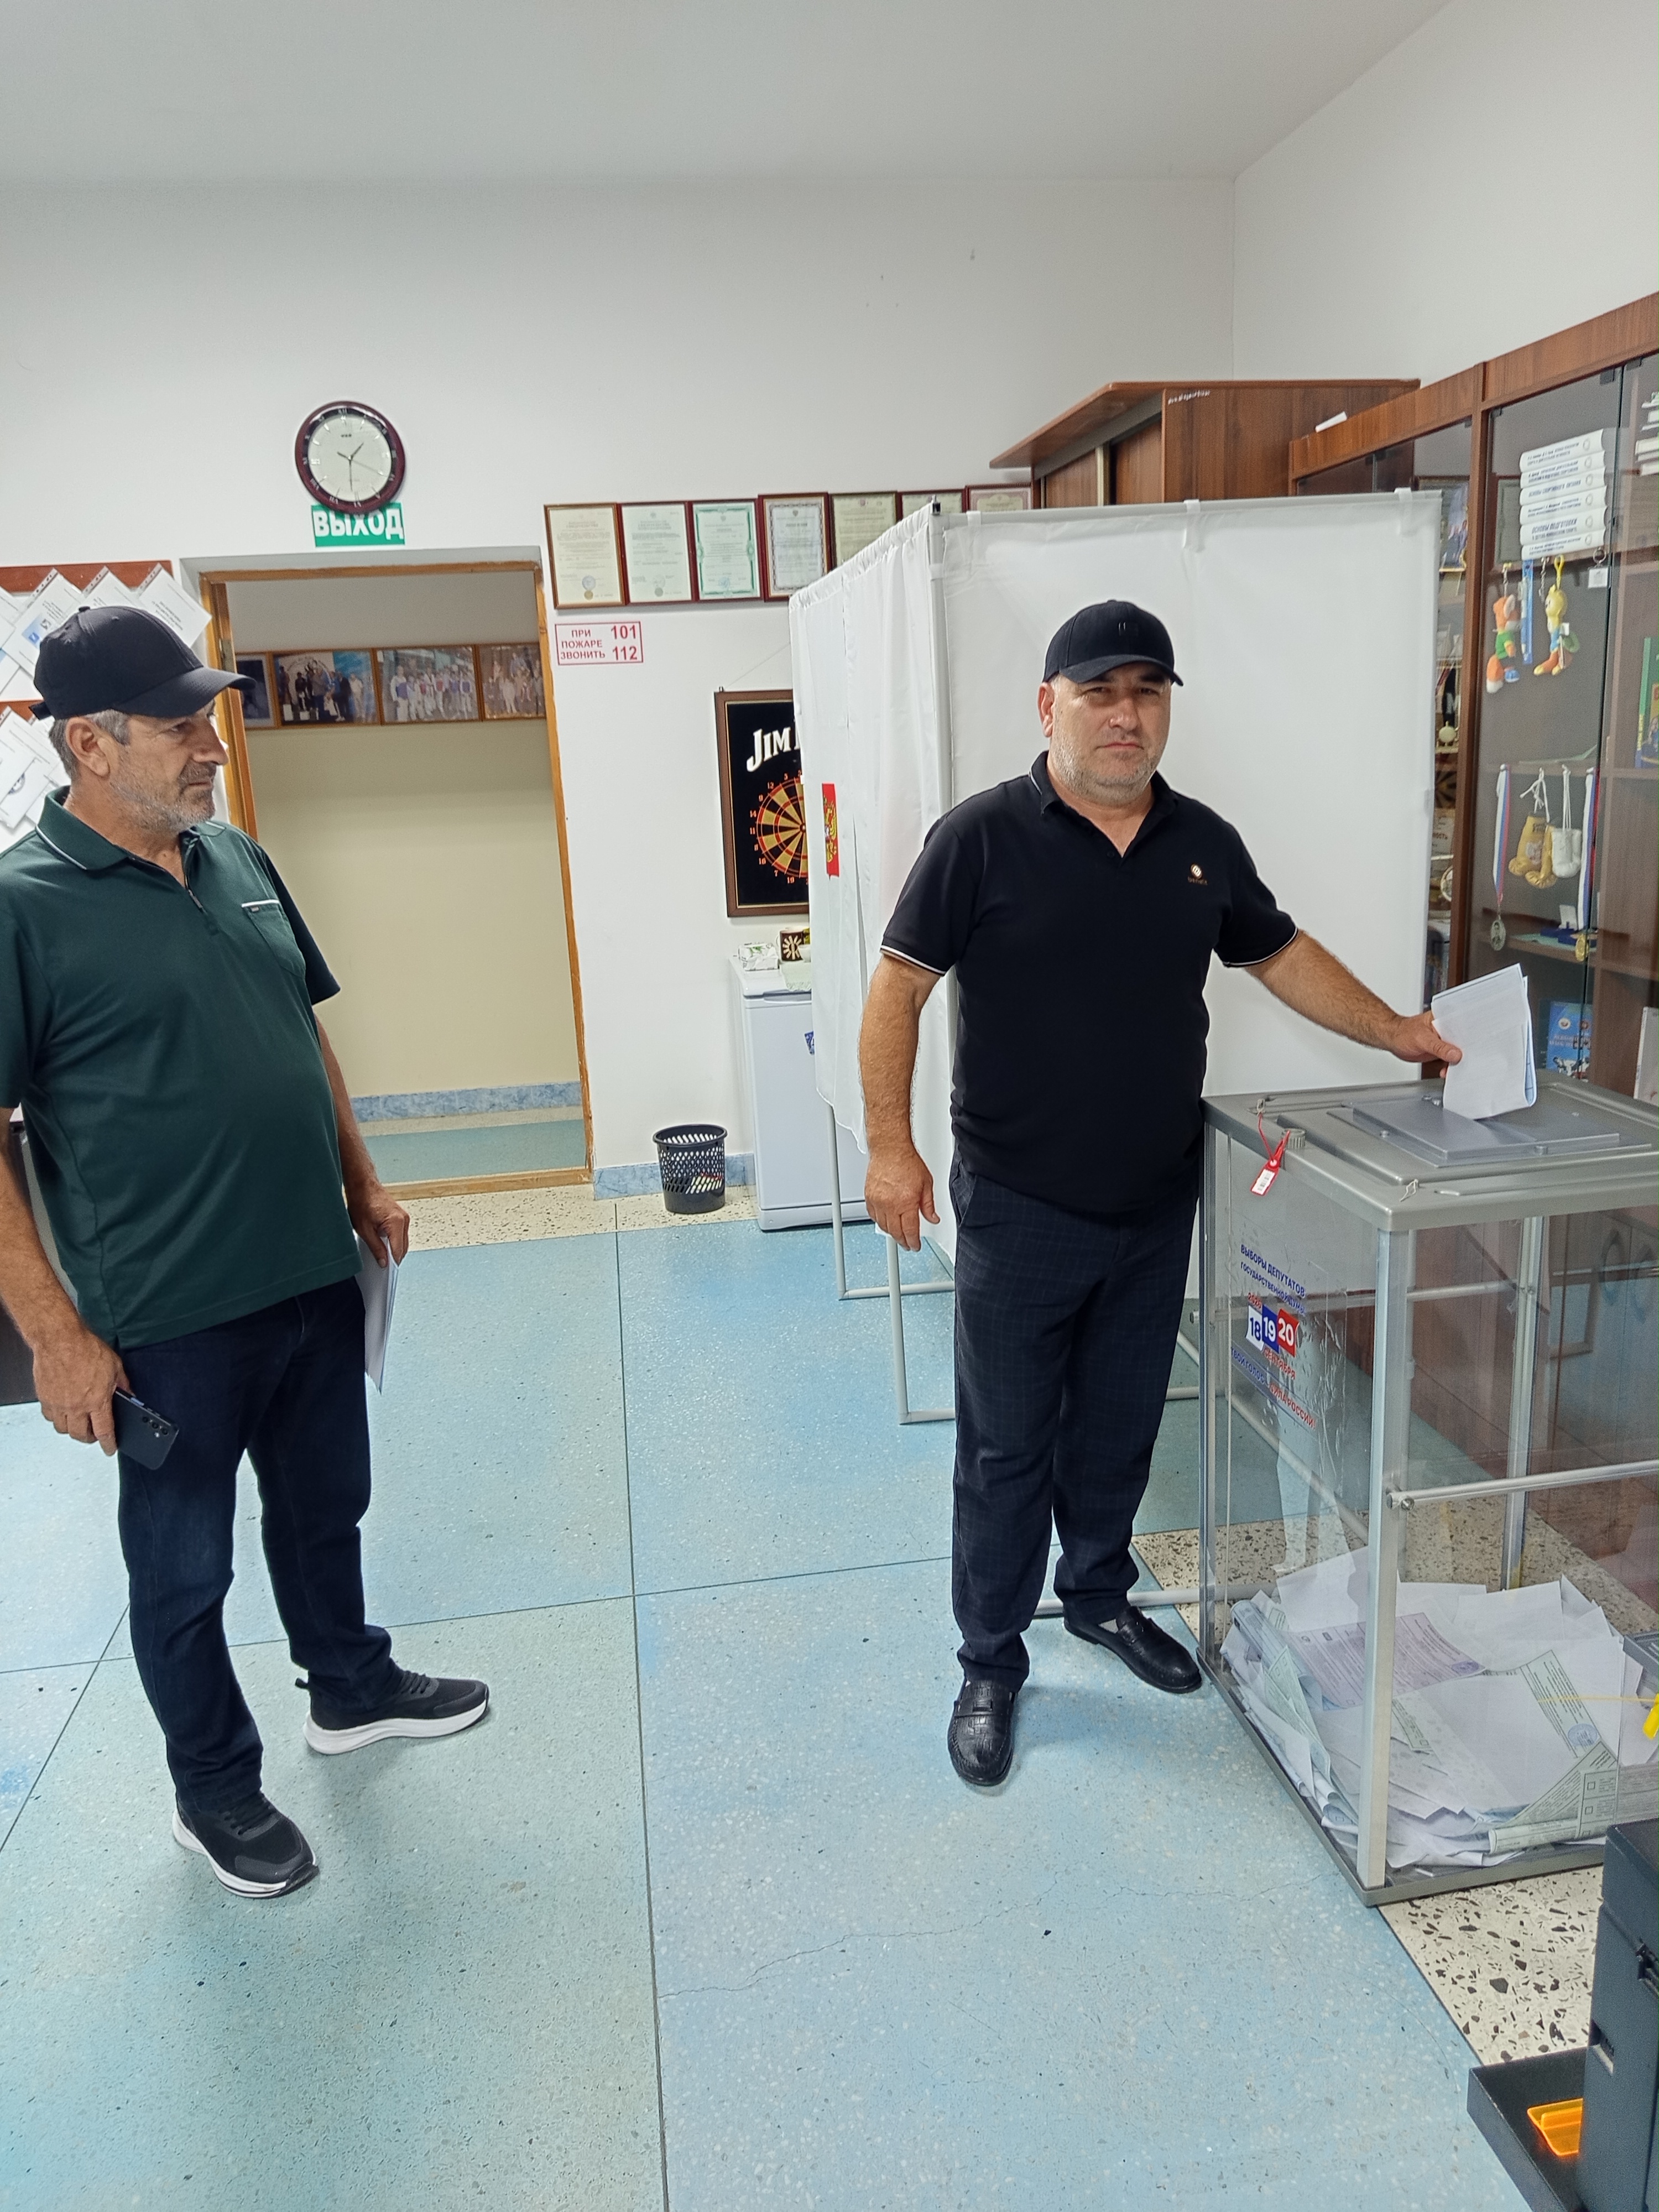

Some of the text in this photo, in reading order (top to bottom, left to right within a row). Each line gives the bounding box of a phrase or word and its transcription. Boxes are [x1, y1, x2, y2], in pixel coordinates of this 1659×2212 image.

[312, 508, 404, 540] ВЫХОД
[561, 640, 603, 649] ПОЖАРЕ
[571, 629, 591, 638] ПРИ
[611, 625, 636, 639] 101
[560, 650, 606, 660] ЗВОНИТЬ
[613, 646, 638, 661] 112
[747, 727, 791, 772] JIM
[1241, 1244, 1305, 1298] ВЫБОРЫ ДЕПУТАТОВ
[1241, 1261, 1288, 1301] ГОСУДАРСТВЕННОЙ
[1250, 1317, 1294, 1346] 18 19 20
[1264, 1345, 1295, 1380] СЕНТЯБРЯ
[1270, 1384, 1287, 1404] СИЛА
[1287, 1396, 1316, 1429] РОССИИ!
